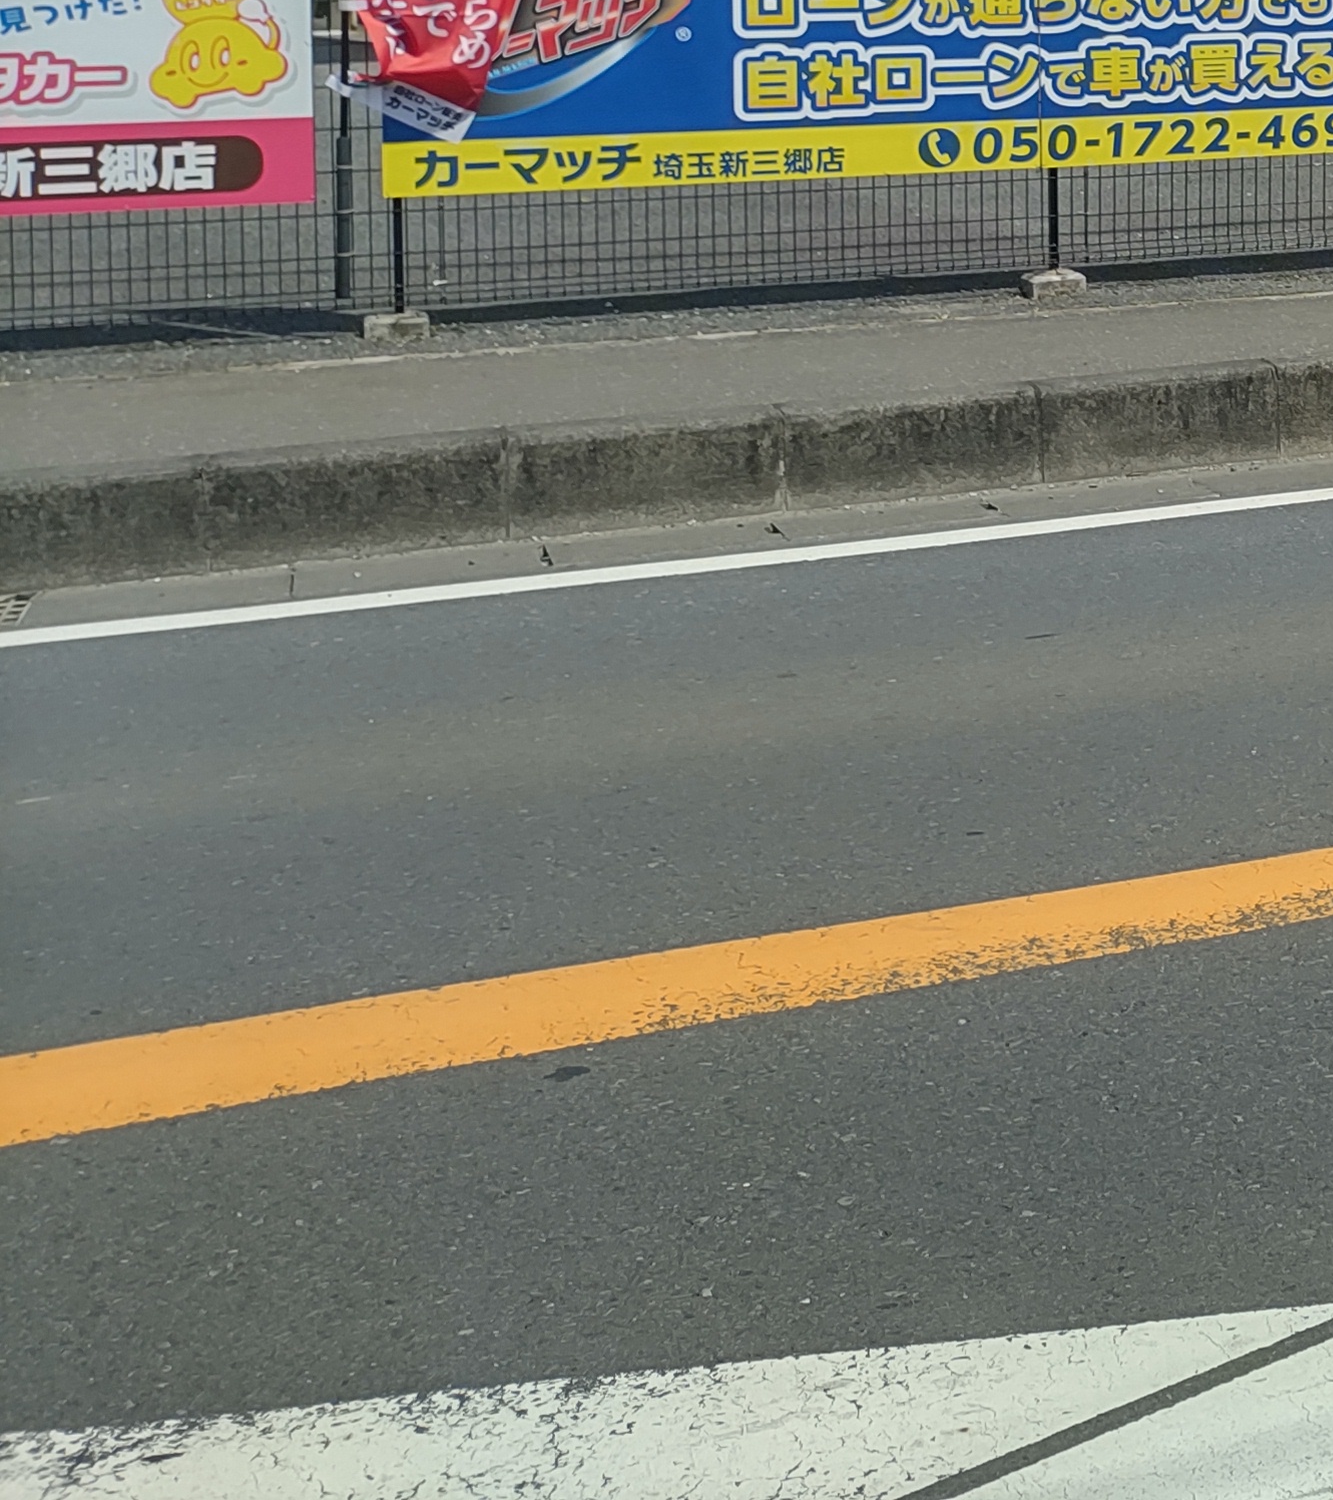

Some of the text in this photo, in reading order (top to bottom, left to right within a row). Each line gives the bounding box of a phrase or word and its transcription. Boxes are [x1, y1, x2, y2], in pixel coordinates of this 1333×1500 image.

[414, 142, 642, 188] カーマッチ
[652, 146, 846, 181] 埼玉新三郷店
